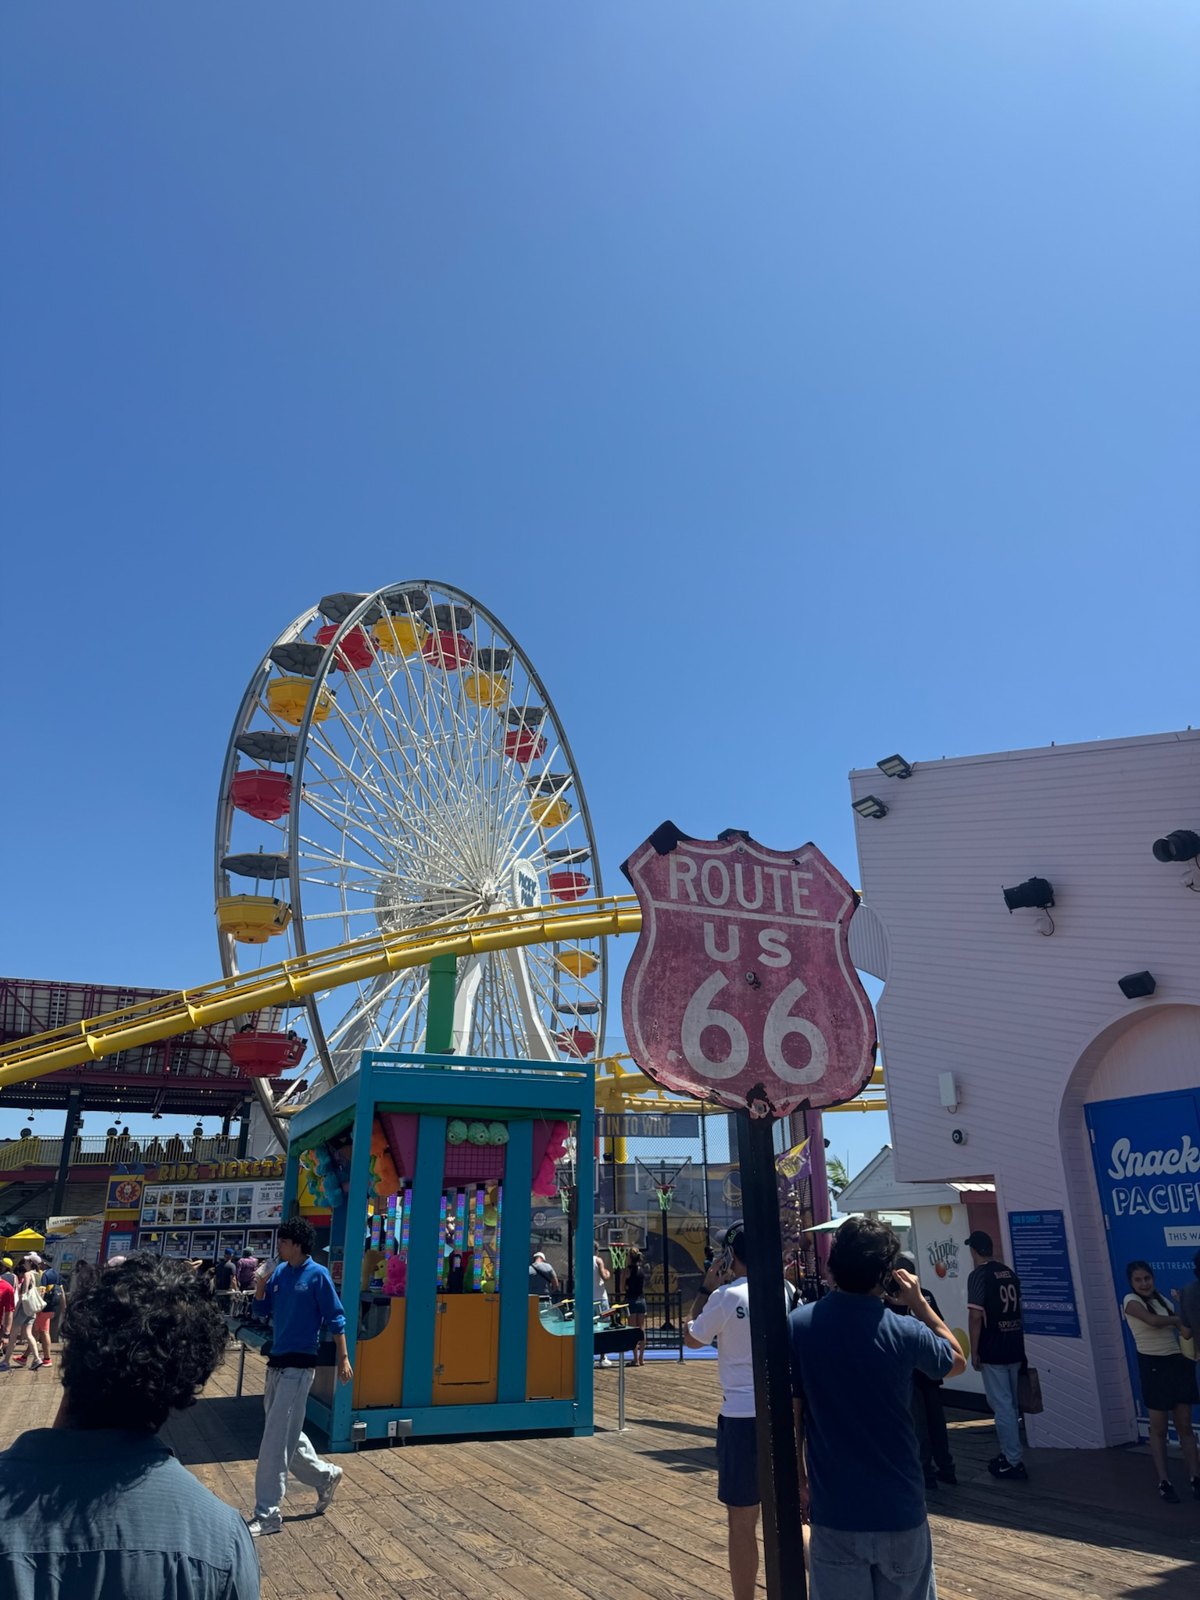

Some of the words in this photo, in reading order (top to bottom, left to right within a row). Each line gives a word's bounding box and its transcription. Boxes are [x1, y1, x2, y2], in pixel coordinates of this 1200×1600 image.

[669, 854, 818, 917] ROUTE
[681, 969, 829, 1085] 66
[624, 1117, 639, 1135] TO
[642, 1117, 671, 1136] WIN!
[159, 1163, 199, 1180] RIDE
[207, 1158, 284, 1178] TICKETS
[1107, 1135, 1200, 1180] Snack
[1168, 1232, 1188, 1241] THIS
[1166, 1261, 1197, 1270] TREATS
[1000, 1284, 1018, 1312] 99
